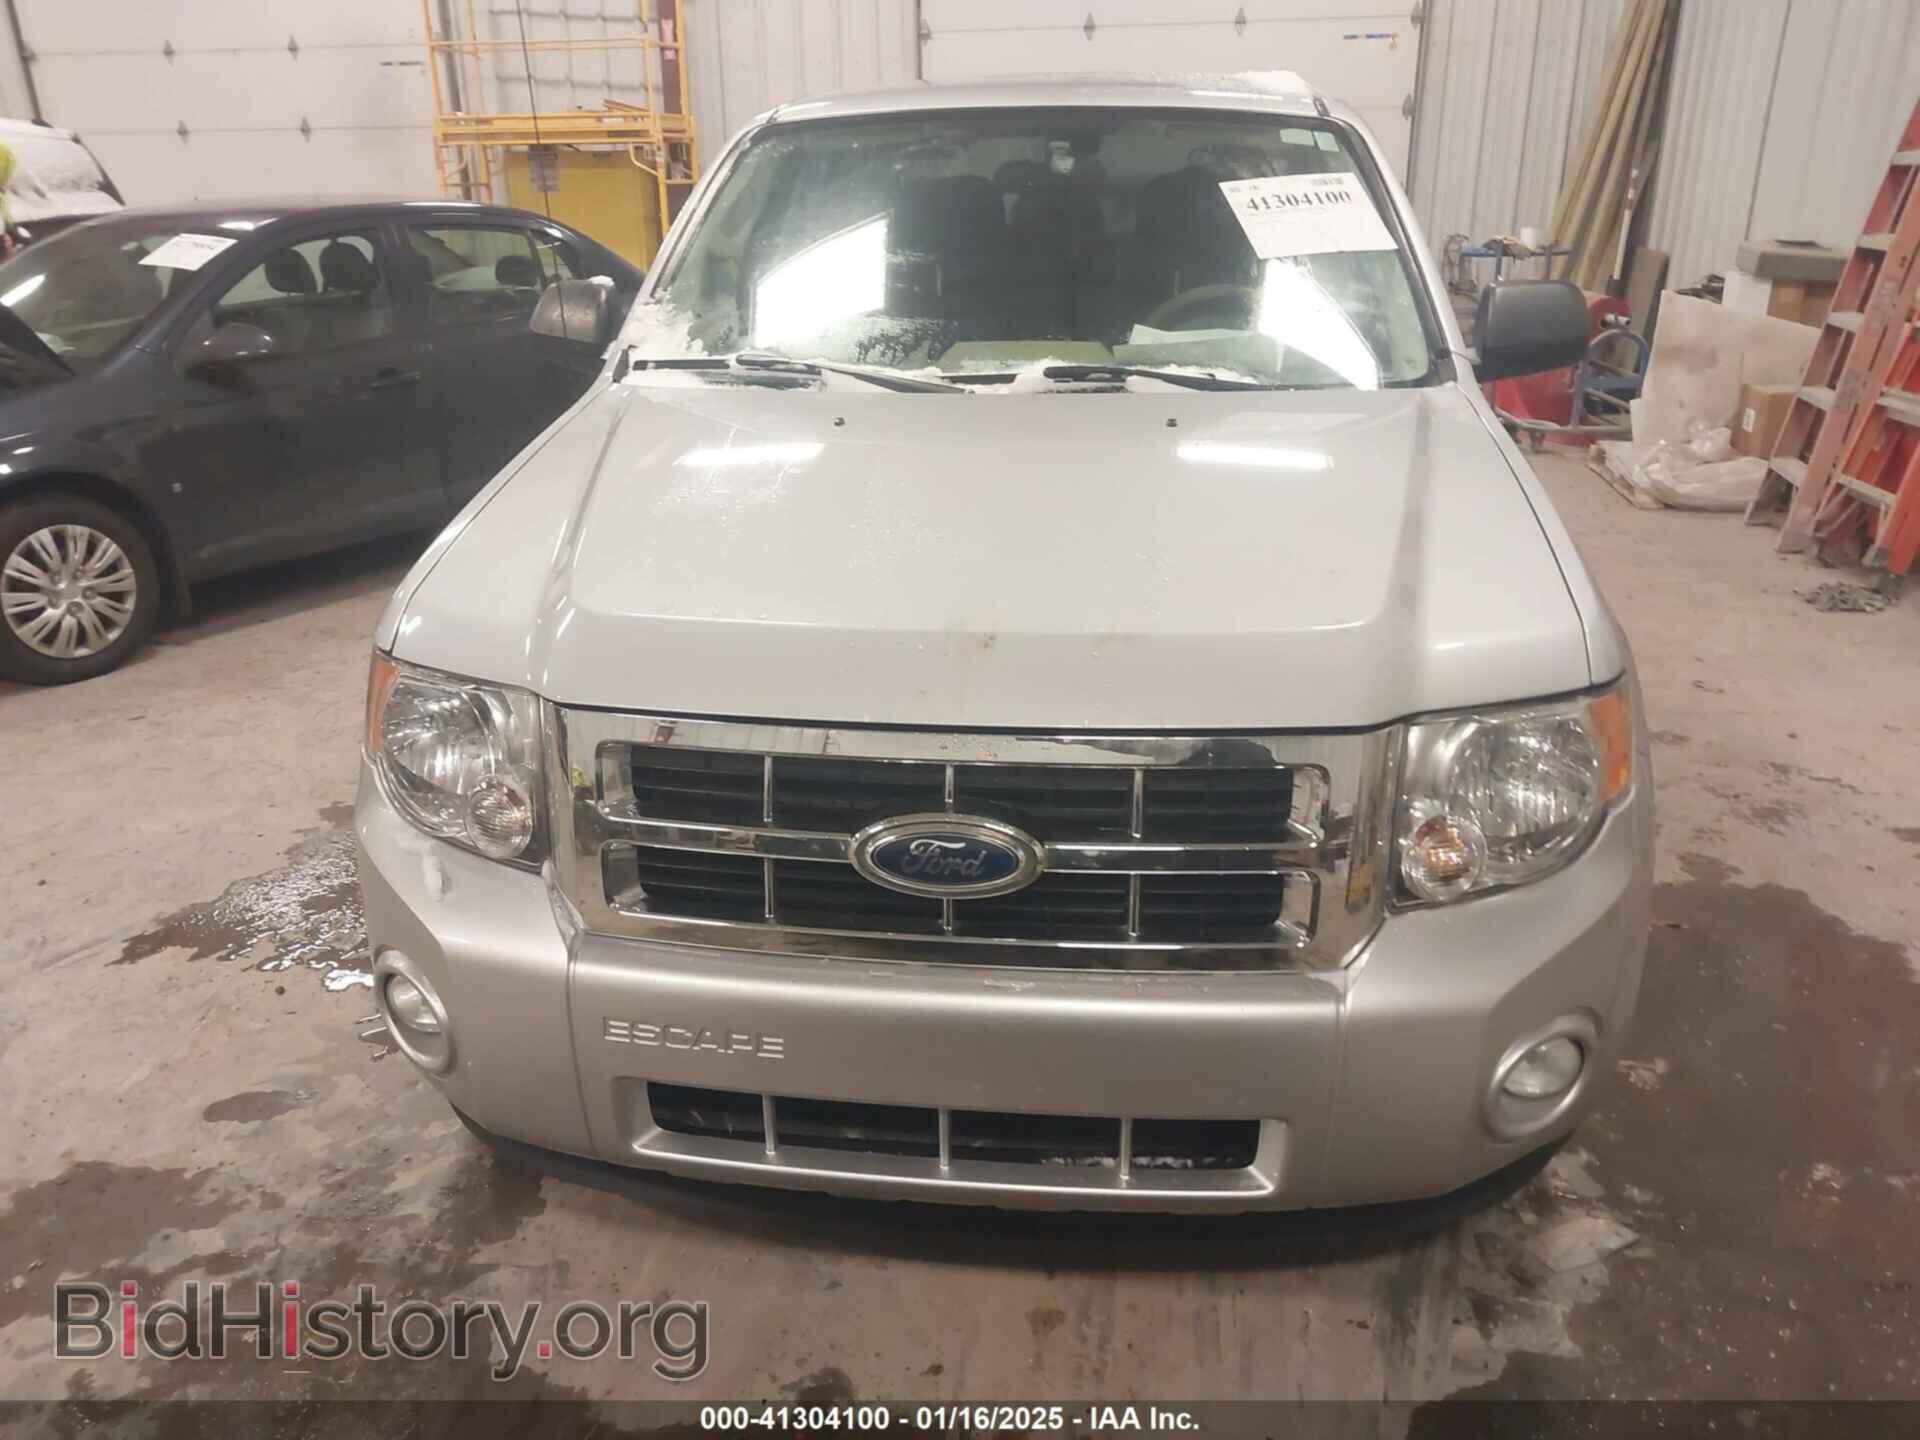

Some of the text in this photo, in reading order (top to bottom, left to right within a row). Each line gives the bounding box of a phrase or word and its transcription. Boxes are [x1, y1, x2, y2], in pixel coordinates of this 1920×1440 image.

[1246, 190, 1352, 211] 41304100
[901, 838, 988, 877] Ford
[603, 1017, 785, 1059] ESCAPE
